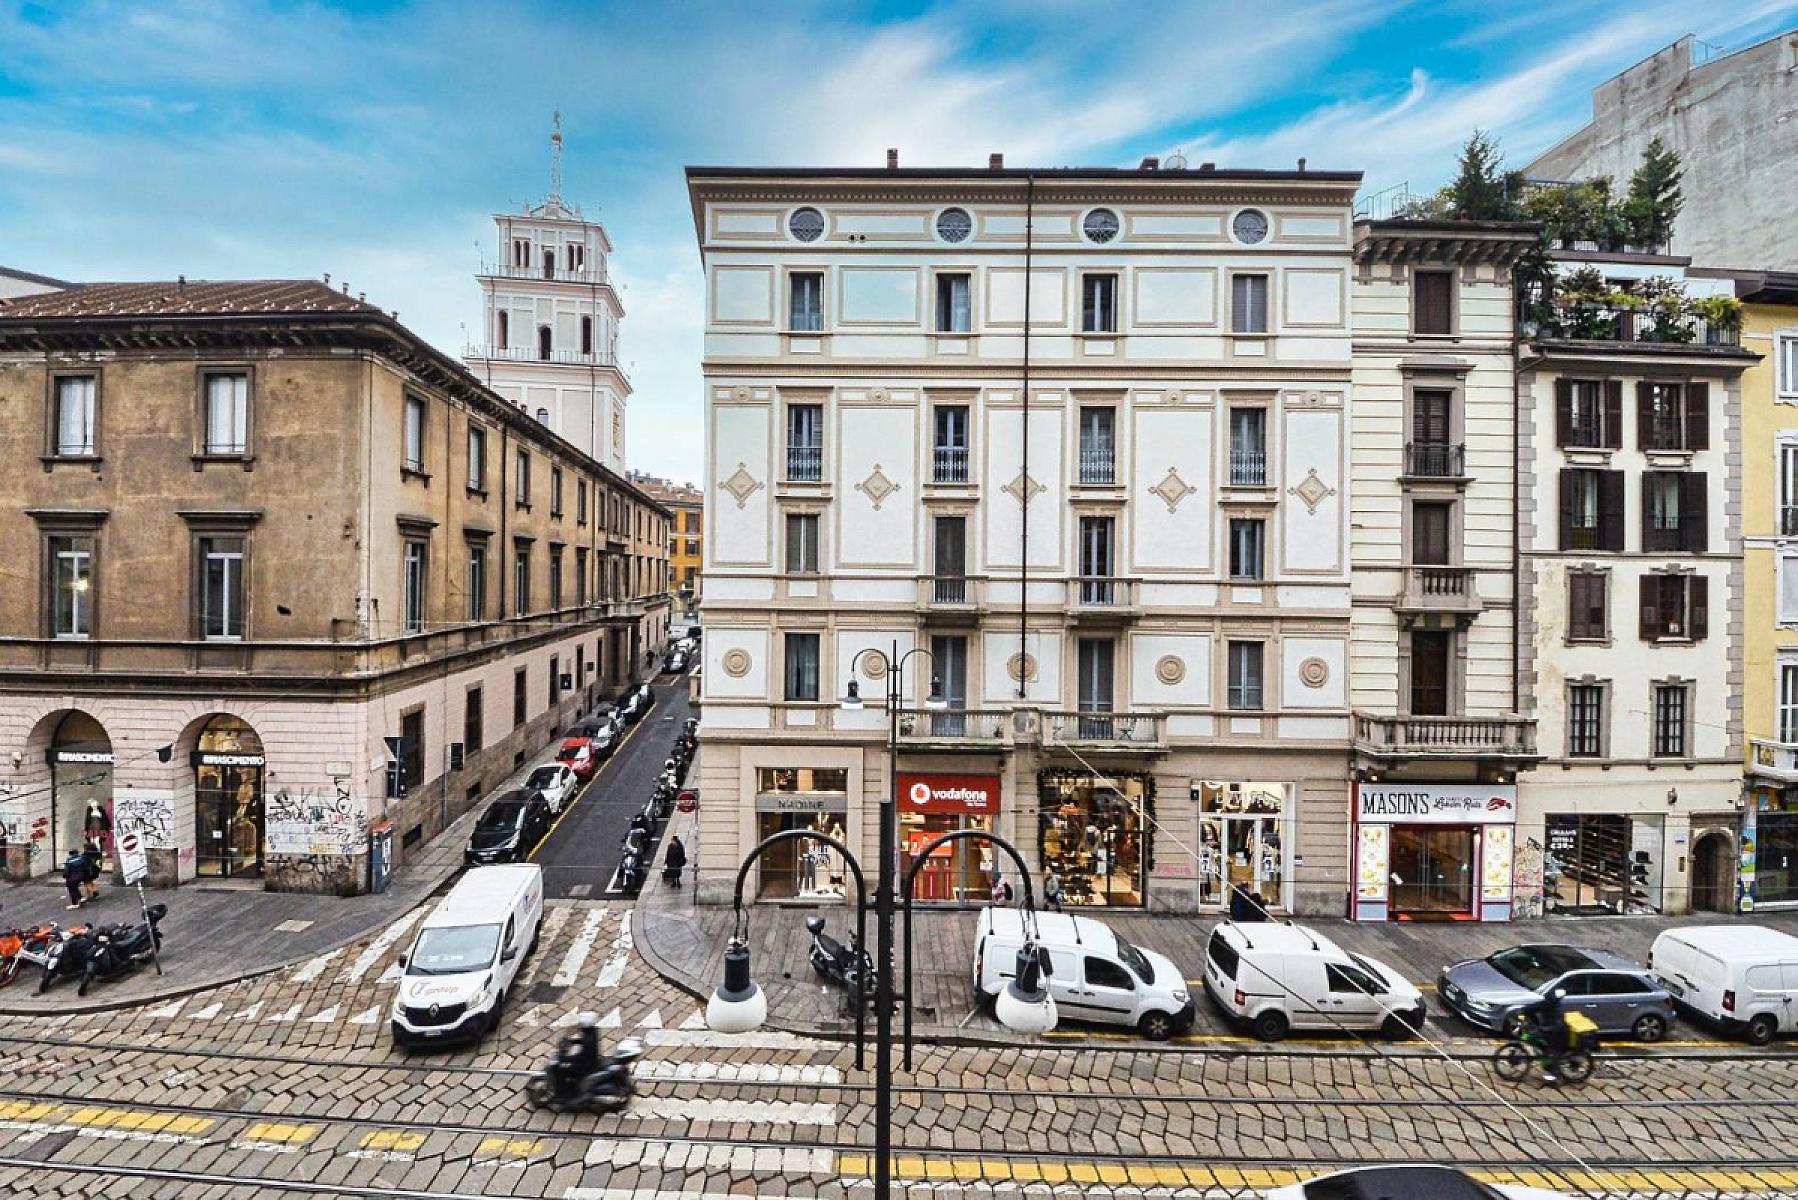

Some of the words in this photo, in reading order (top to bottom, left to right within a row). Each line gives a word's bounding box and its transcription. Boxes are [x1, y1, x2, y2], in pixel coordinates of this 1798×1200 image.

[203, 755, 264, 765] RINASCIMENTO
[932, 787, 987, 801] vodafone
[778, 799, 825, 810] NADINE
[1362, 792, 1429, 815] MASON'S
